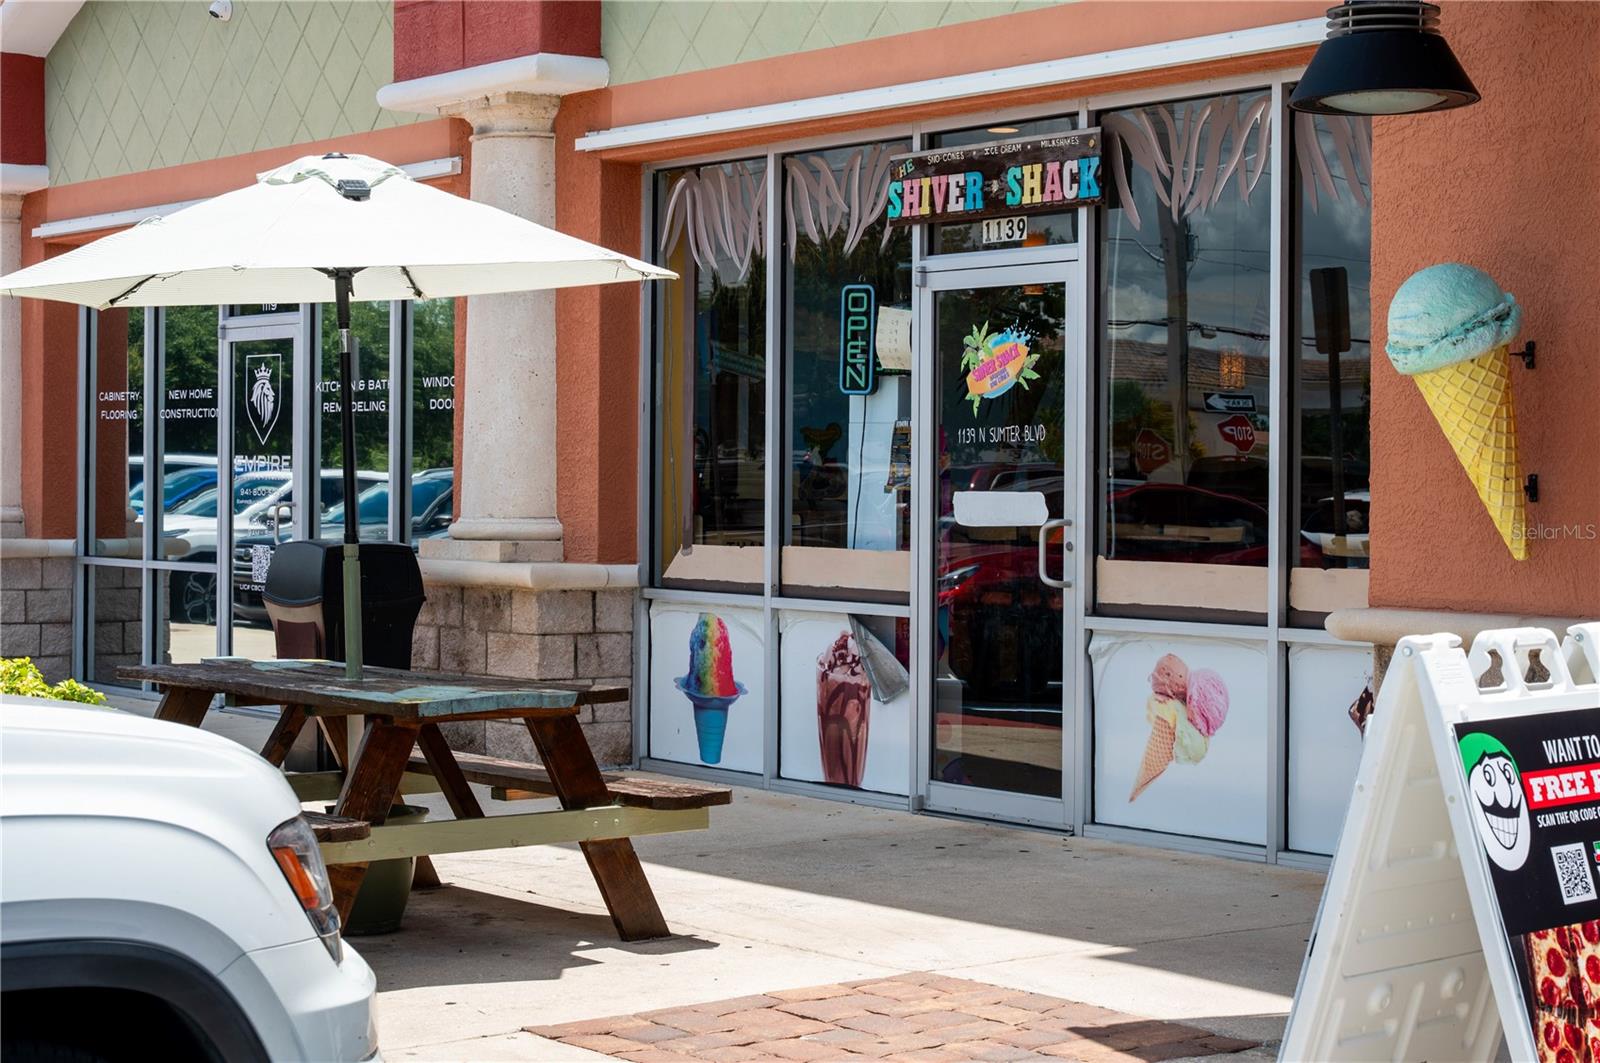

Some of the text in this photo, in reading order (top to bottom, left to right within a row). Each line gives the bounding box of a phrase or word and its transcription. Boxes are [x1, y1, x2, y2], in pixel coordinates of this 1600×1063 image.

[984, 146, 998, 156] ICE
[1001, 143, 1022, 155] CREAM
[1041, 136, 1080, 149] MILKSHAKES
[887, 156, 1101, 219] SHIVER SHACK
[984, 218, 1027, 242] 1139
[846, 292, 868, 388] OPEN
[168, 388, 213, 400] NEW HOME
[315, 381, 356, 392] KITCHN
[359, 380, 365, 391] &
[98, 391, 140, 402] CABINETRY
[323, 400, 386, 413] REMDELING
[101, 410, 138, 420] FLOORING
[958, 423, 1046, 444] 1139 N SUMTER BLVD
[233, 455, 291, 473] EMPIRE
[1542, 734, 1600, 764] WANT TO
[1528, 771, 1590, 803] FREE
[1536, 812, 1556, 828] SCAN
[1555, 811, 1570, 825] THE
[1569, 809, 1580, 824] QR
[1580, 806, 1596, 821] CODE
